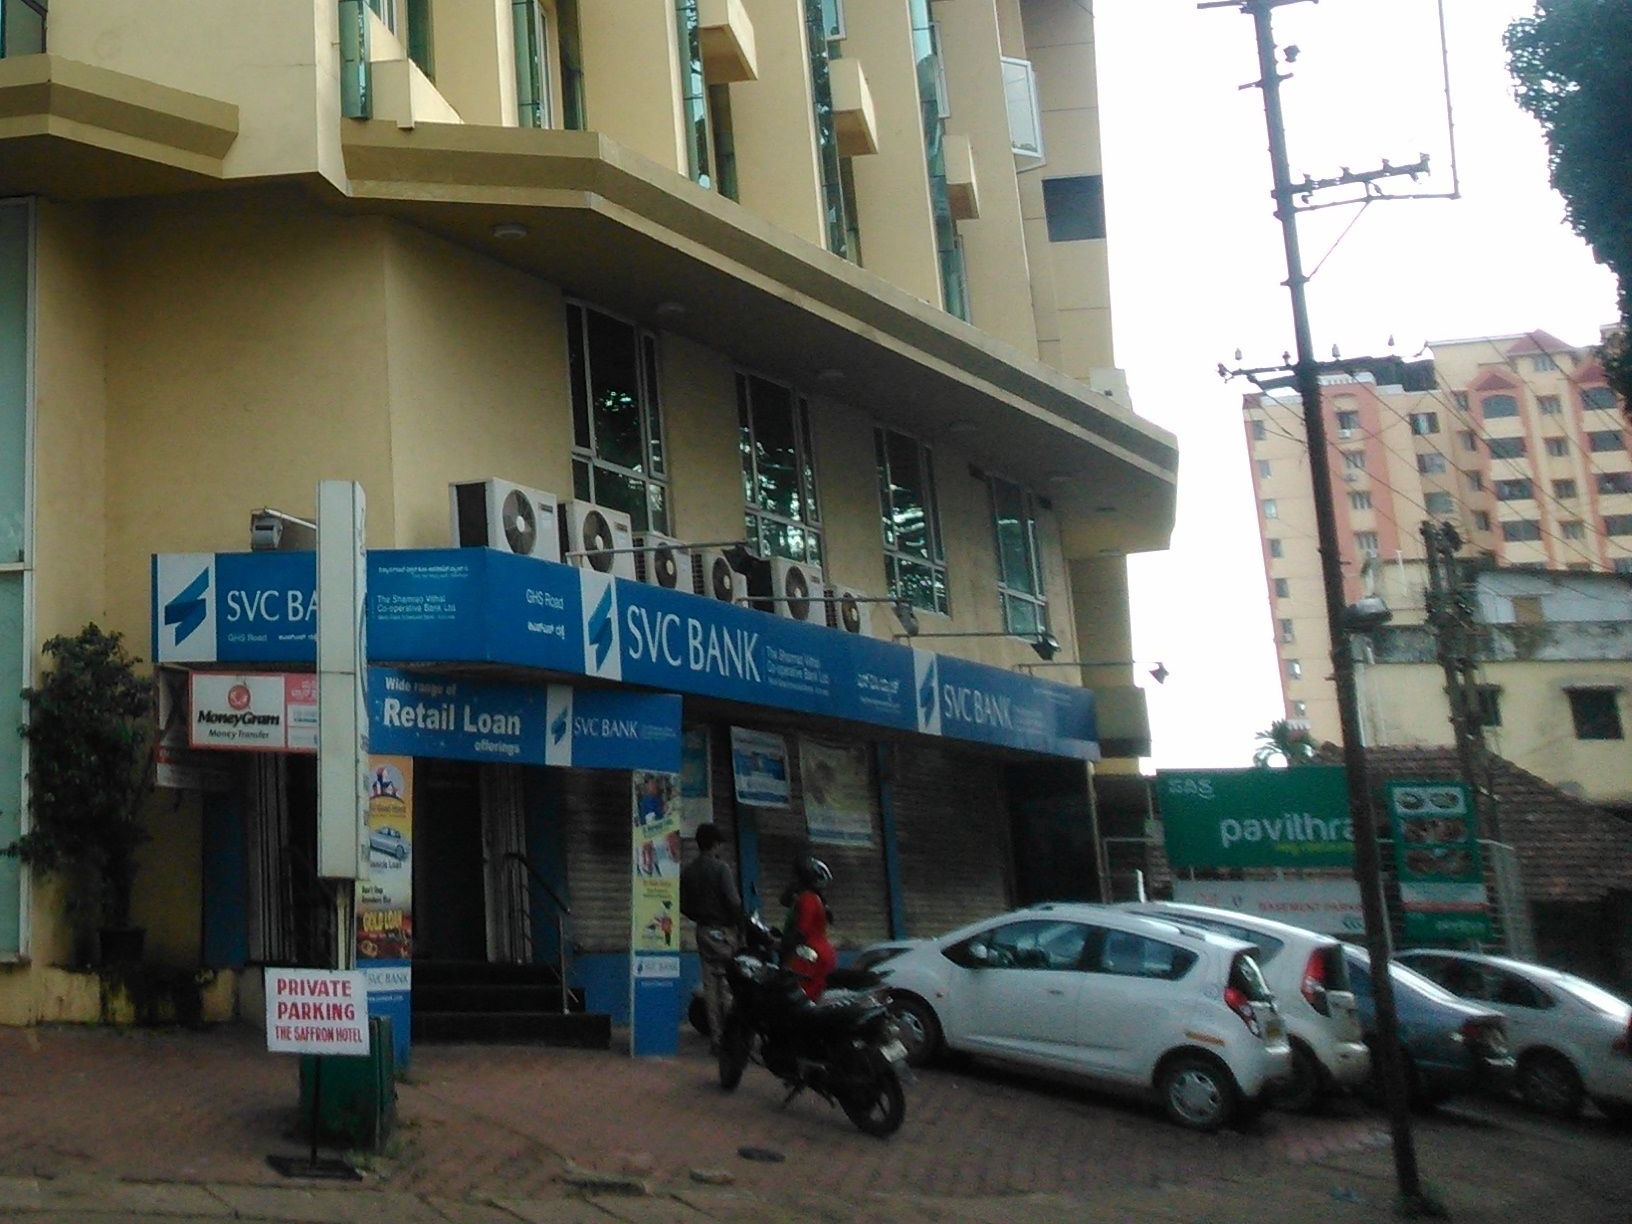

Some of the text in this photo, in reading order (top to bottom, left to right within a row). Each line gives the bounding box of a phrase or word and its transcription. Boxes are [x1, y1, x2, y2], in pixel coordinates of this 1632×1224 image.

[227, 590, 318, 622] SVC BA
[526, 588, 565, 611] GHS Road
[627, 605, 762, 683] SVC BANK
[385, 676, 411, 693] Wide
[383, 697, 522, 736] Retail Loan
[944, 684, 972, 722] SVC
[974, 689, 1014, 730] BANK
[197, 710, 281, 728] MoneyGram
[574, 716, 599, 737] SVC
[601, 719, 640, 741] BANK
[209, 729, 237, 741] Money
[277, 978, 352, 998] PRIVATE
[278, 1001, 356, 1021] PARKING
[275, 1025, 363, 1044] THE SAFFRON HOTEL
